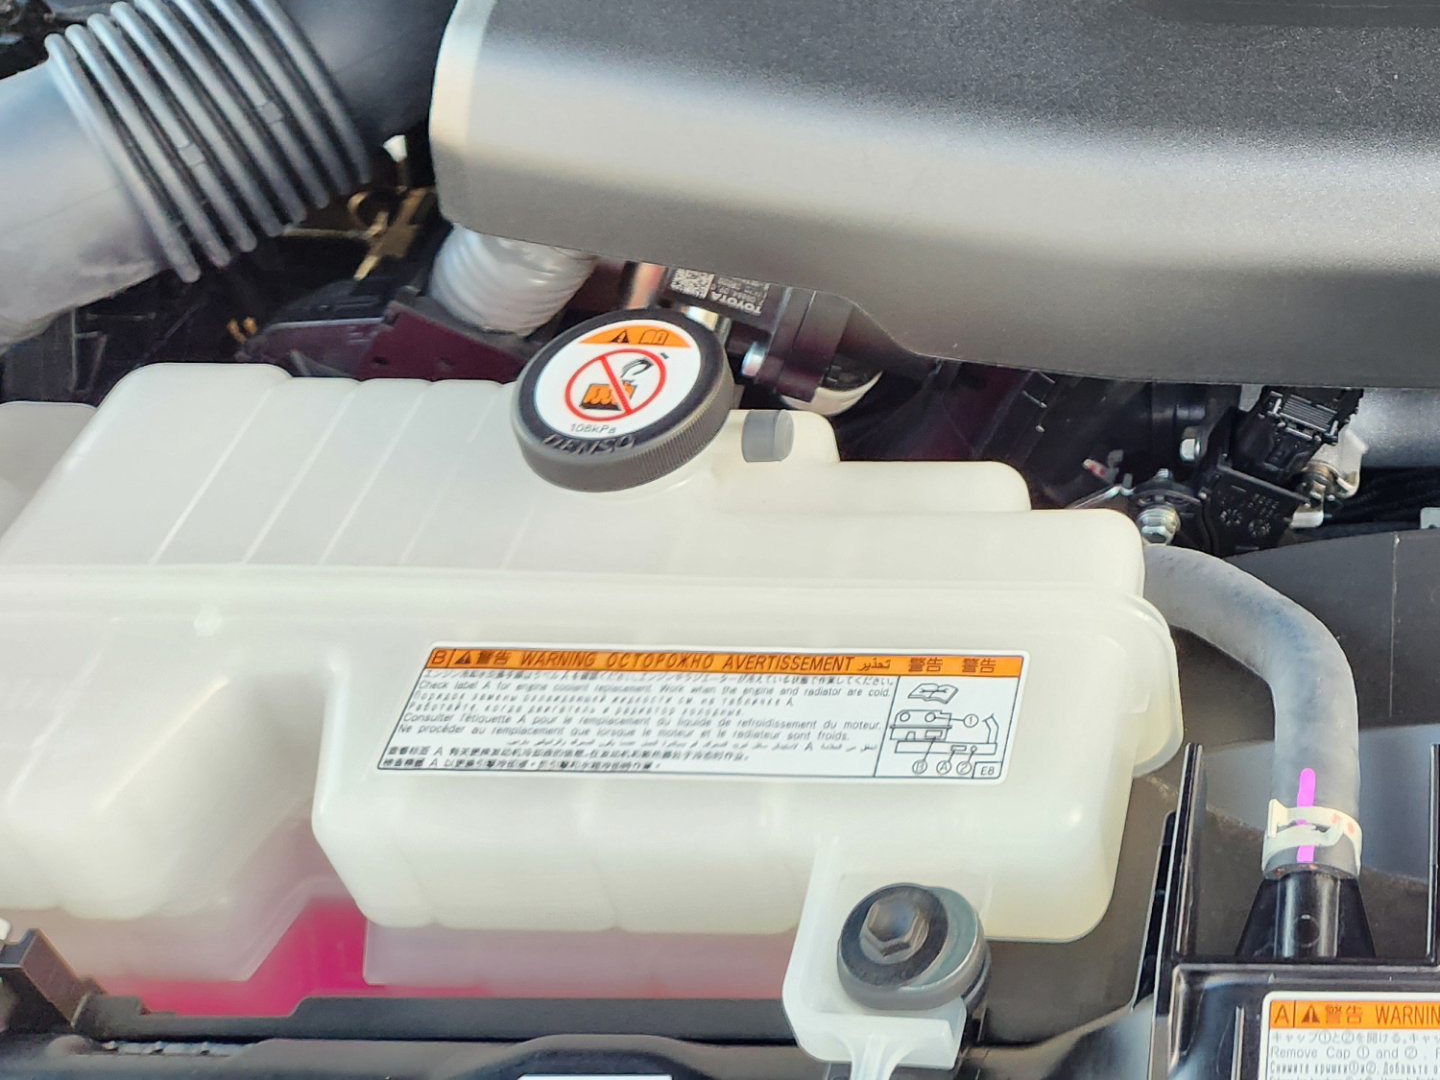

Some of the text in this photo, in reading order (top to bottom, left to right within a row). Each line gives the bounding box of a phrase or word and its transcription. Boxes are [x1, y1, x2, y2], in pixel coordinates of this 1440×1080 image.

[711, 291, 762, 316] TOYOTA
[571, 423, 617, 434] 108kPa
[431, 650, 448, 665] B
[520, 651, 597, 668] WARNING
[607, 652, 714, 669] ОСТОРОЖНО
[722, 655, 855, 672] AVERTISSEMENT
[908, 657, 943, 672] 警告
[962, 658, 997, 674] 警告
[455, 680, 477, 690] label
[497, 681, 510, 690] for
[742, 686, 773, 697] engine
[779, 687, 799, 696] and
[804, 686, 842, 697] radiator
[847, 688, 863, 697] are
[398, 723, 413, 733] Ne
[823, 720, 837, 729] du
[980, 766, 995, 776] E8
[1273, 1005, 1290, 1025] A
[1271, 1046, 1318, 1059] Remove
[1326, 1046, 1351, 1061] Cap
[1376, 1047, 1399, 1059] and
